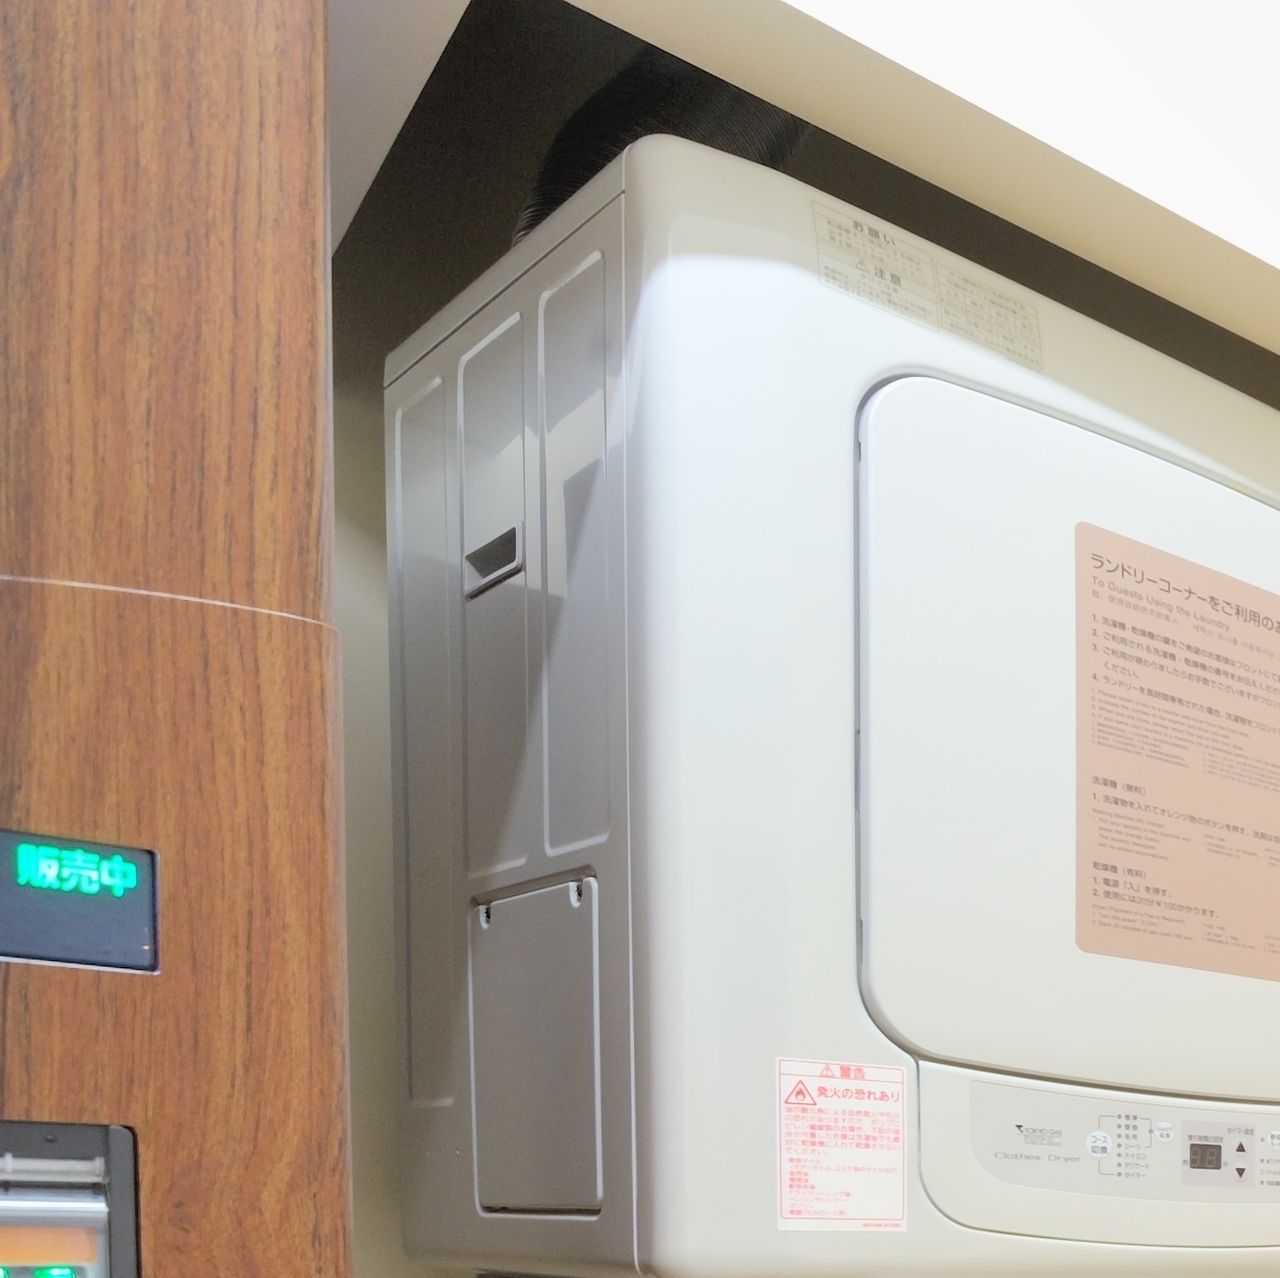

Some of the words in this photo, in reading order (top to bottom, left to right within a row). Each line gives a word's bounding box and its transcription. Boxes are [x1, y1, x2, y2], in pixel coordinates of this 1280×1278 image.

[1092, 575, 1104, 588] To
[1108, 581, 1143, 602] Guests
[1147, 594, 1173, 614] Using
[1176, 605, 1190, 618] the
[1194, 611, 1229, 633] Laundry
[16, 843, 138, 898] 販売中
[816, 1086, 900, 1103] 発火の恐れあり
[994, 1152, 1041, 1160] Clothes
[1048, 1154, 1080, 1163] Dryer
